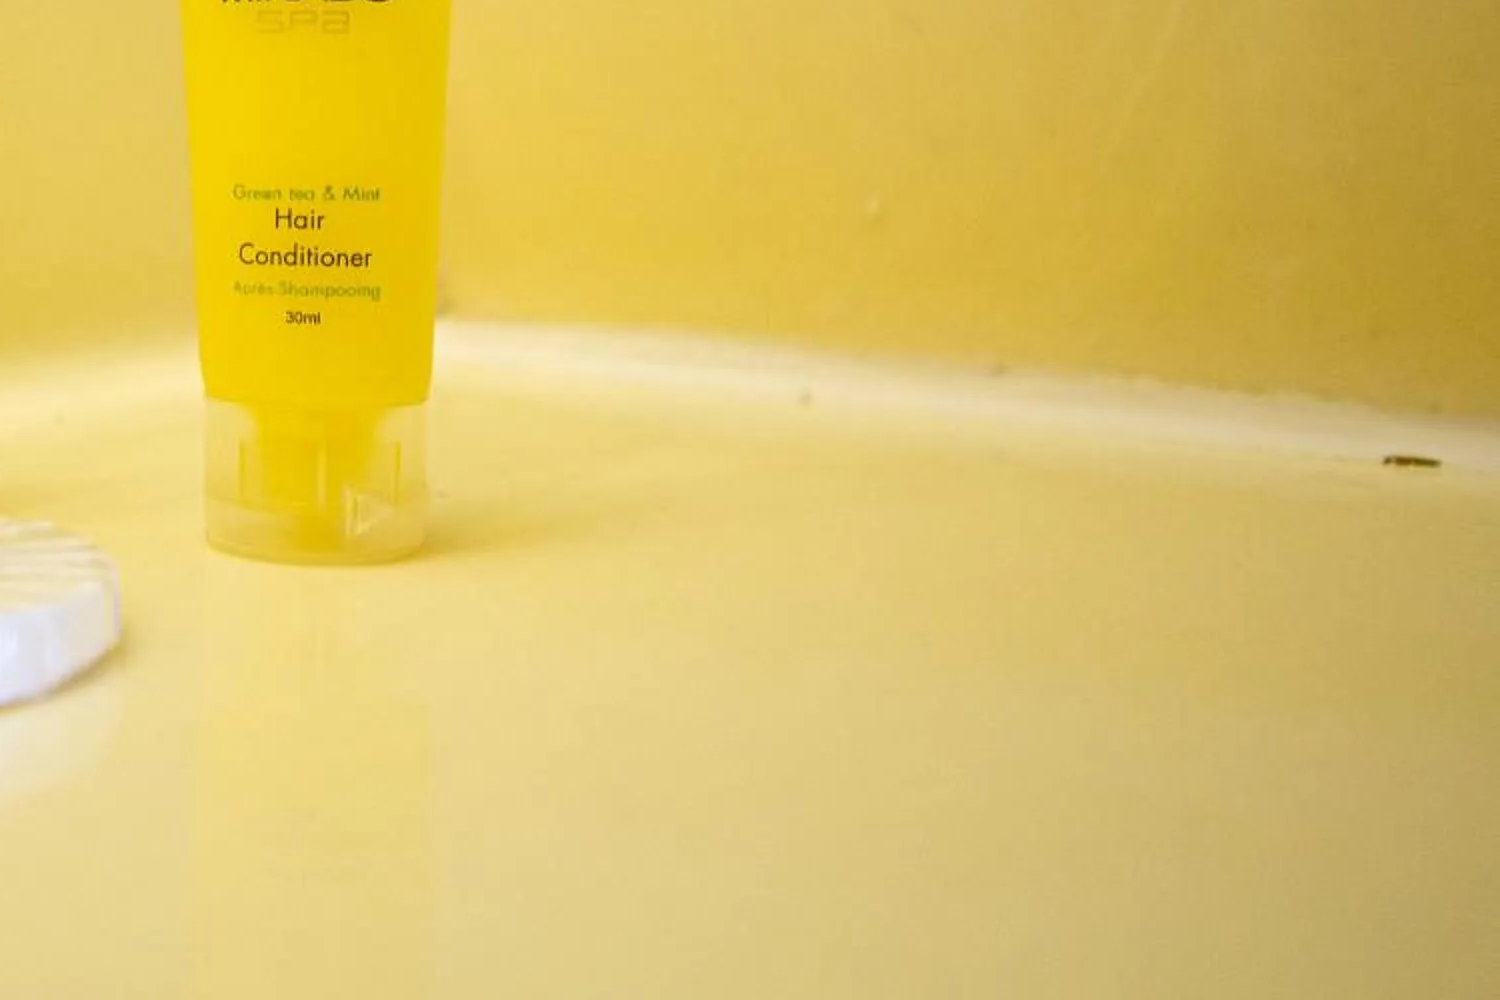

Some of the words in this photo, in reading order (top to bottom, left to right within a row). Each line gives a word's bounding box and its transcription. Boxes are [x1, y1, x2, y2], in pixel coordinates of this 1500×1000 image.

[232, 183, 282, 202] Green
[288, 187, 316, 202] tea
[322, 185, 337, 202] &
[342, 186, 381, 202] Mint
[274, 206, 325, 231] Hair
[238, 241, 373, 268] Conditioner
[284, 310, 322, 326] 30ml
